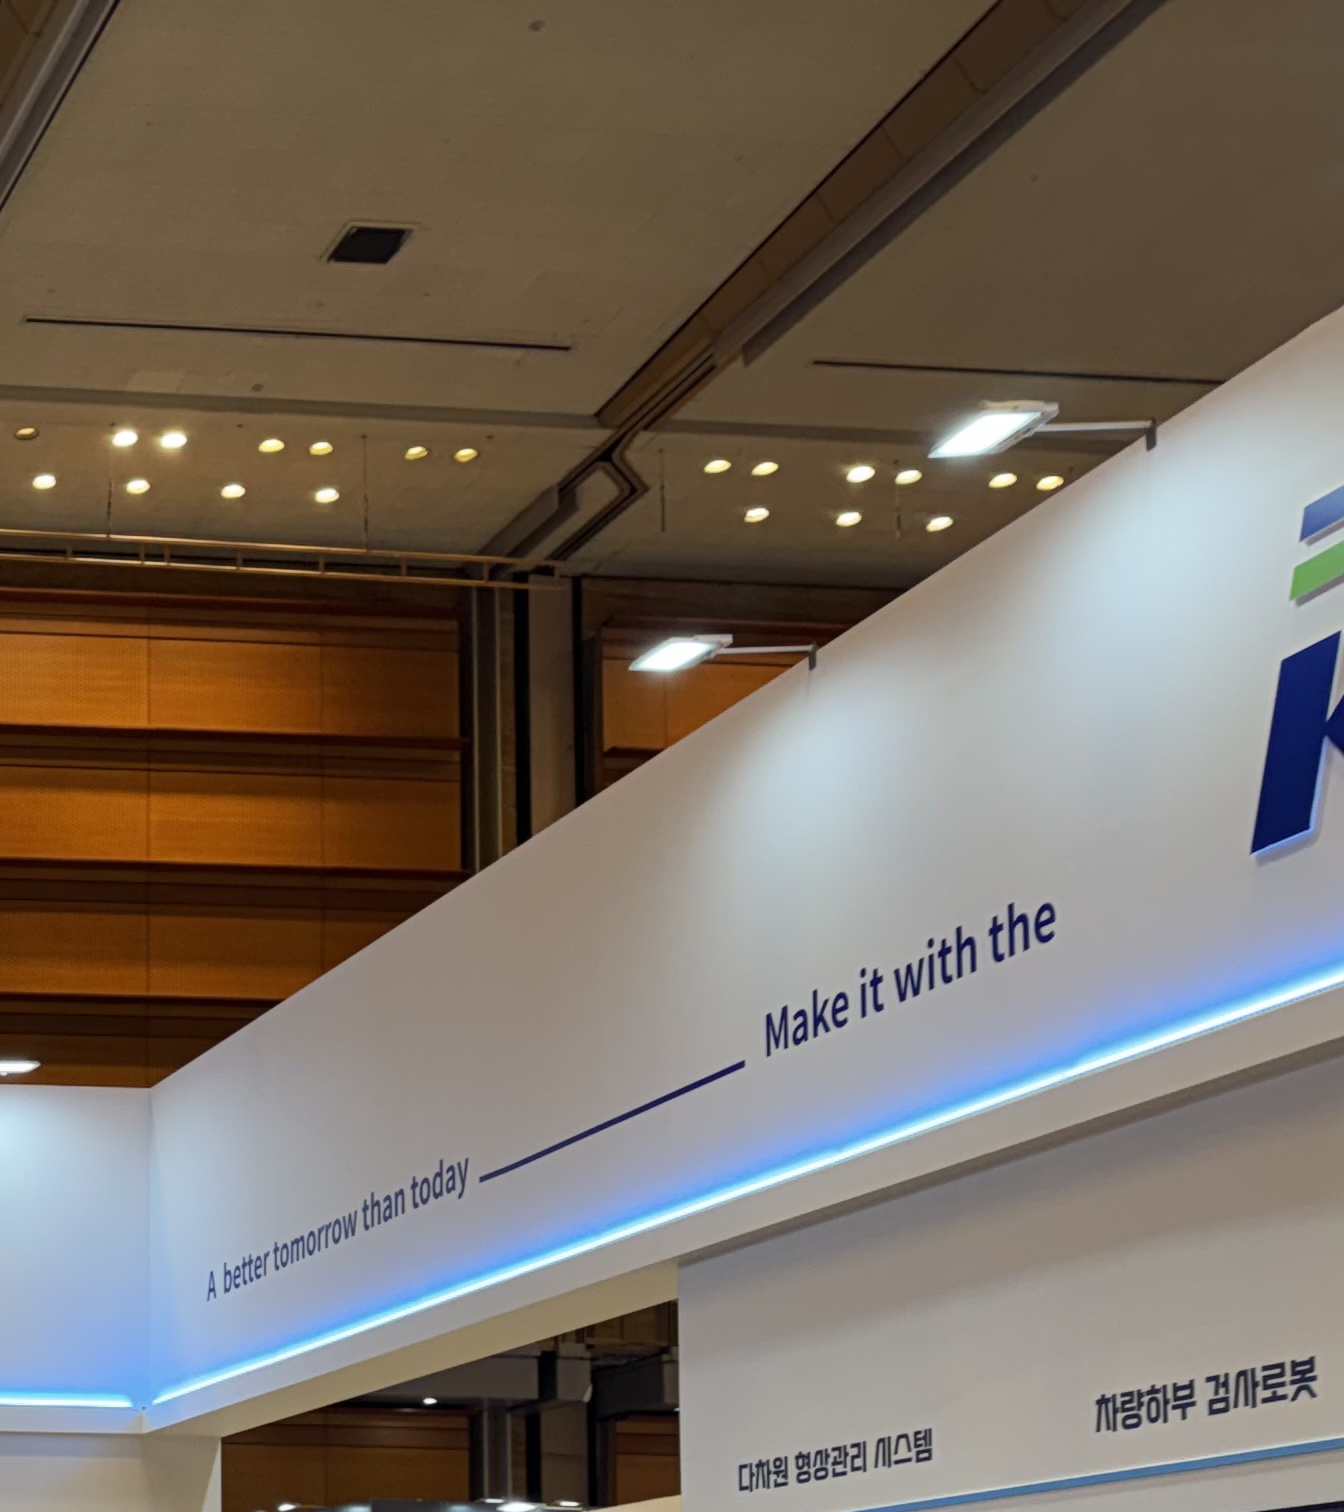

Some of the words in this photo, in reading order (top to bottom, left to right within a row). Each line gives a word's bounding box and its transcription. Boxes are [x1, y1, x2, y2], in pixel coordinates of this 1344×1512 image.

[207, 1270, 217, 1301] A
[223, 1250, 270, 1294] better
[273, 1209, 358, 1272] tomorrow
[362, 1191, 406, 1231] than
[411, 1157, 469, 1210] today
[765, 988, 849, 1058] Make
[860, 967, 884, 1019] it
[893, 925, 977, 1003] with
[988, 902, 1056, 964] the
[1095, 1379, 1197, 1433] 차량하부
[1205, 1356, 1319, 1416] 검사로봇
[738, 1455, 789, 1492] 다차원
[795, 1440, 867, 1484] 형상관리
[874, 1428, 933, 1468] 시스템
